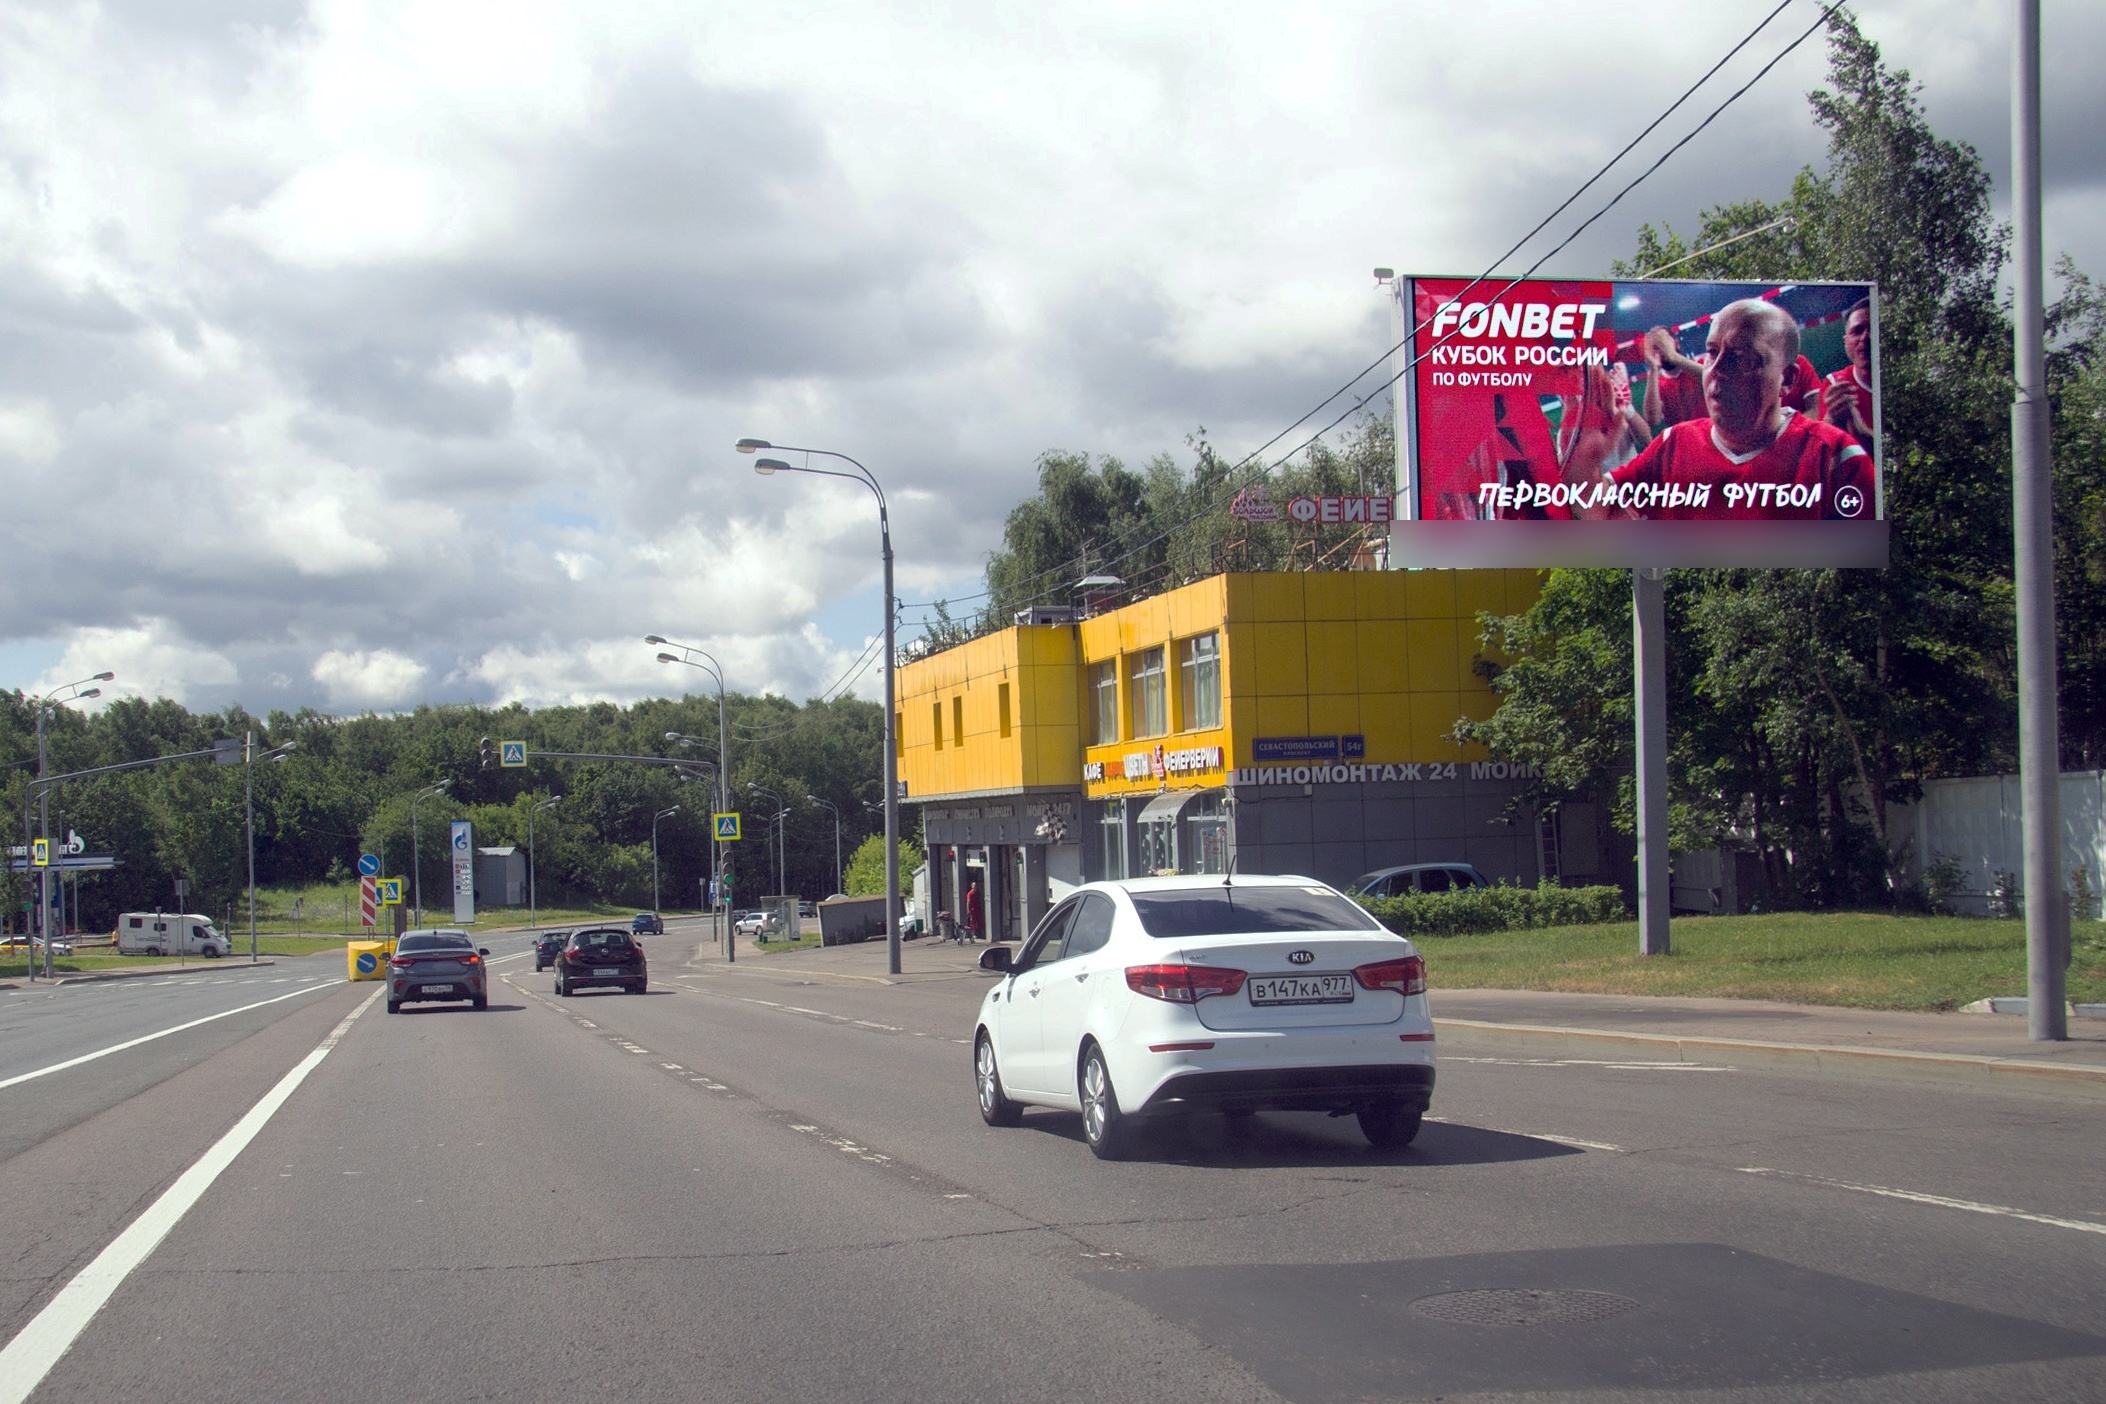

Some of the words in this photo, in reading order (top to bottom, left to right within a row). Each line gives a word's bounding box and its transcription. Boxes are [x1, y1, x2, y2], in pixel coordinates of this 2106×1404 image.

[1431, 302, 1606, 339] FONBET
[1432, 345, 1507, 366] КУБОК
[1515, 346, 1609, 367] РОССИИ
[1433, 372, 1455, 387] ПО
[1458, 371, 1533, 387] ФУТБОЛУ
[1478, 480, 1713, 510] ПЕРВОКЛАССНЫЙ
[1722, 482, 1823, 509] ФУТБОЛ
[1840, 494, 1860, 509] 6+
[1289, 497, 1395, 522] ФЕЙЕ
[1258, 740, 1336, 751] СЕВАСТОПОЛЬСКИЙ
[1084, 762, 1104, 780] КАФЕ
[1235, 763, 1423, 785] ШИНОМОНТАЖ
[1429, 762, 1457, 780] 24
[1291, 953, 1312, 962] KIA
